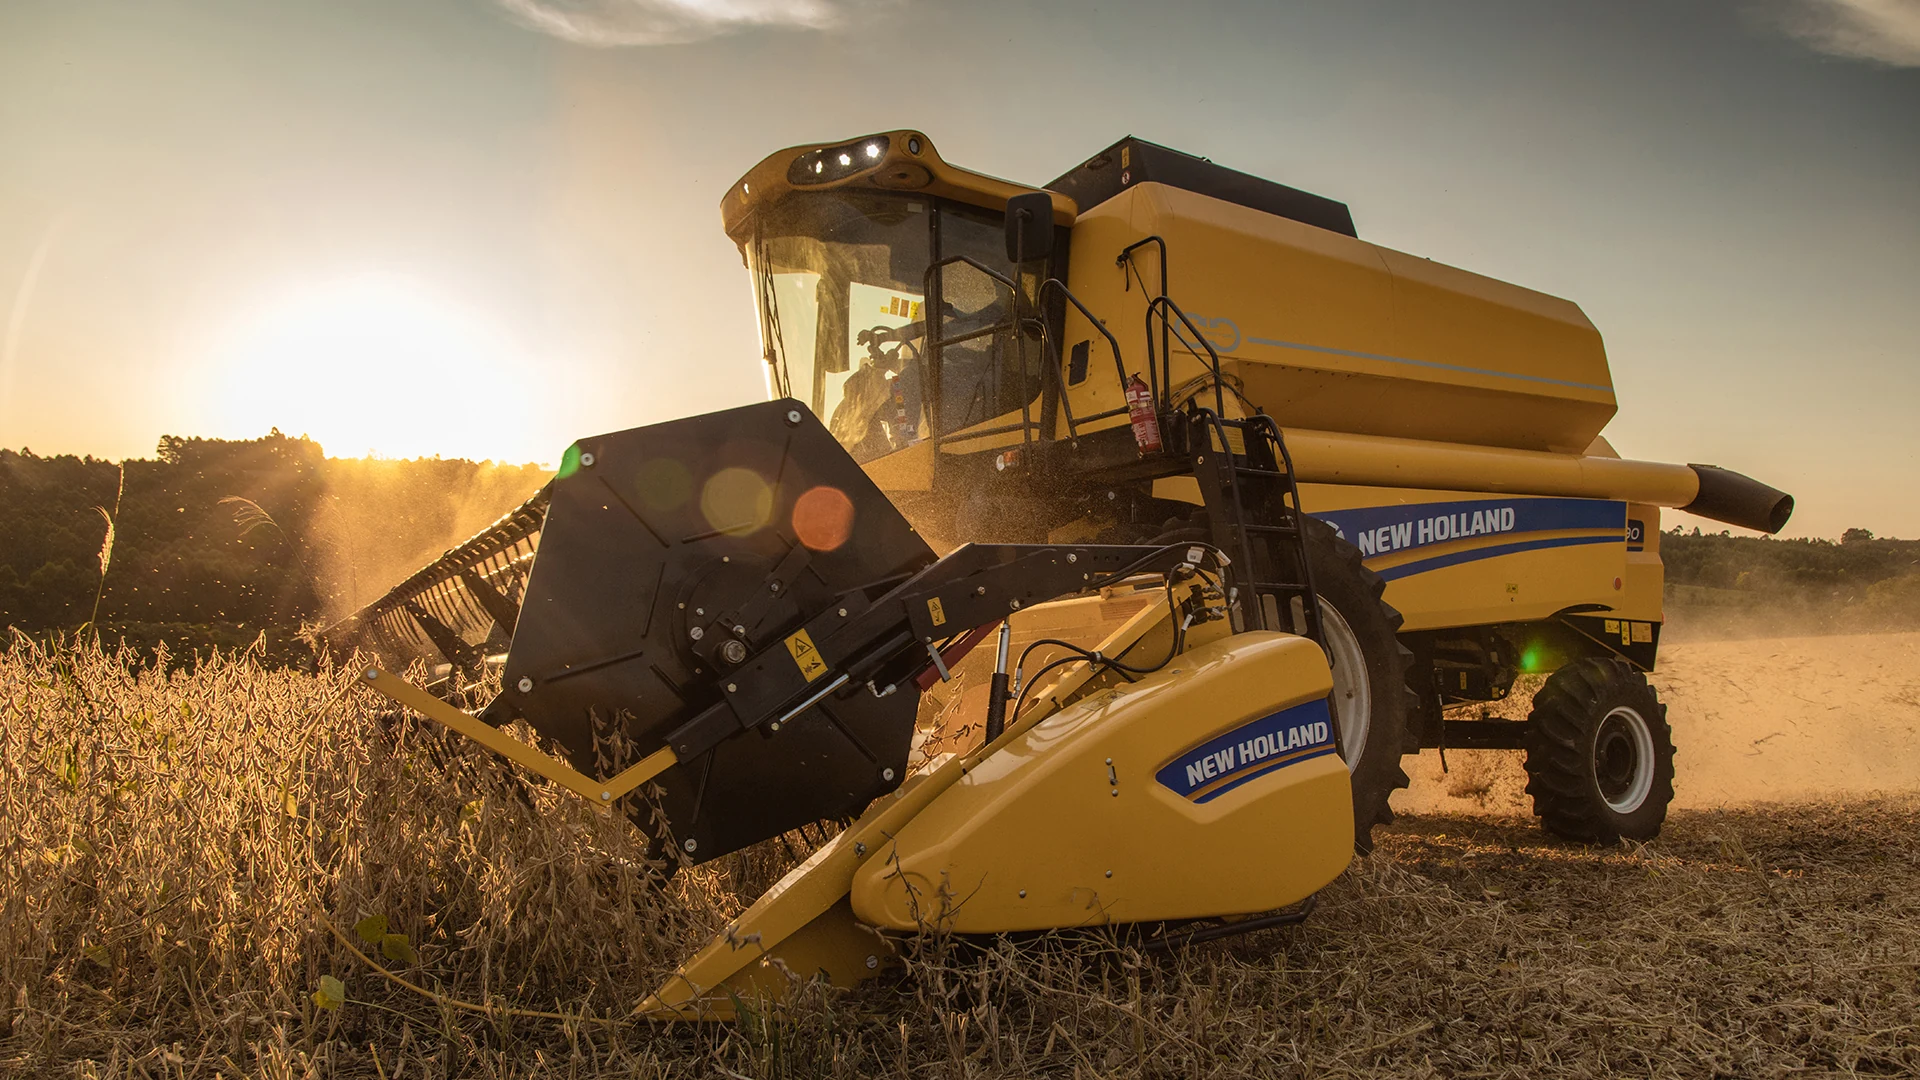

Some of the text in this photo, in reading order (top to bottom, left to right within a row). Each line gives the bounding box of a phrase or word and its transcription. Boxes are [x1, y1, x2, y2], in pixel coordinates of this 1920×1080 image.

[1358, 507, 1515, 556] NEW HOLLAND
[1185, 721, 1328, 787] NEW HOLLAND
